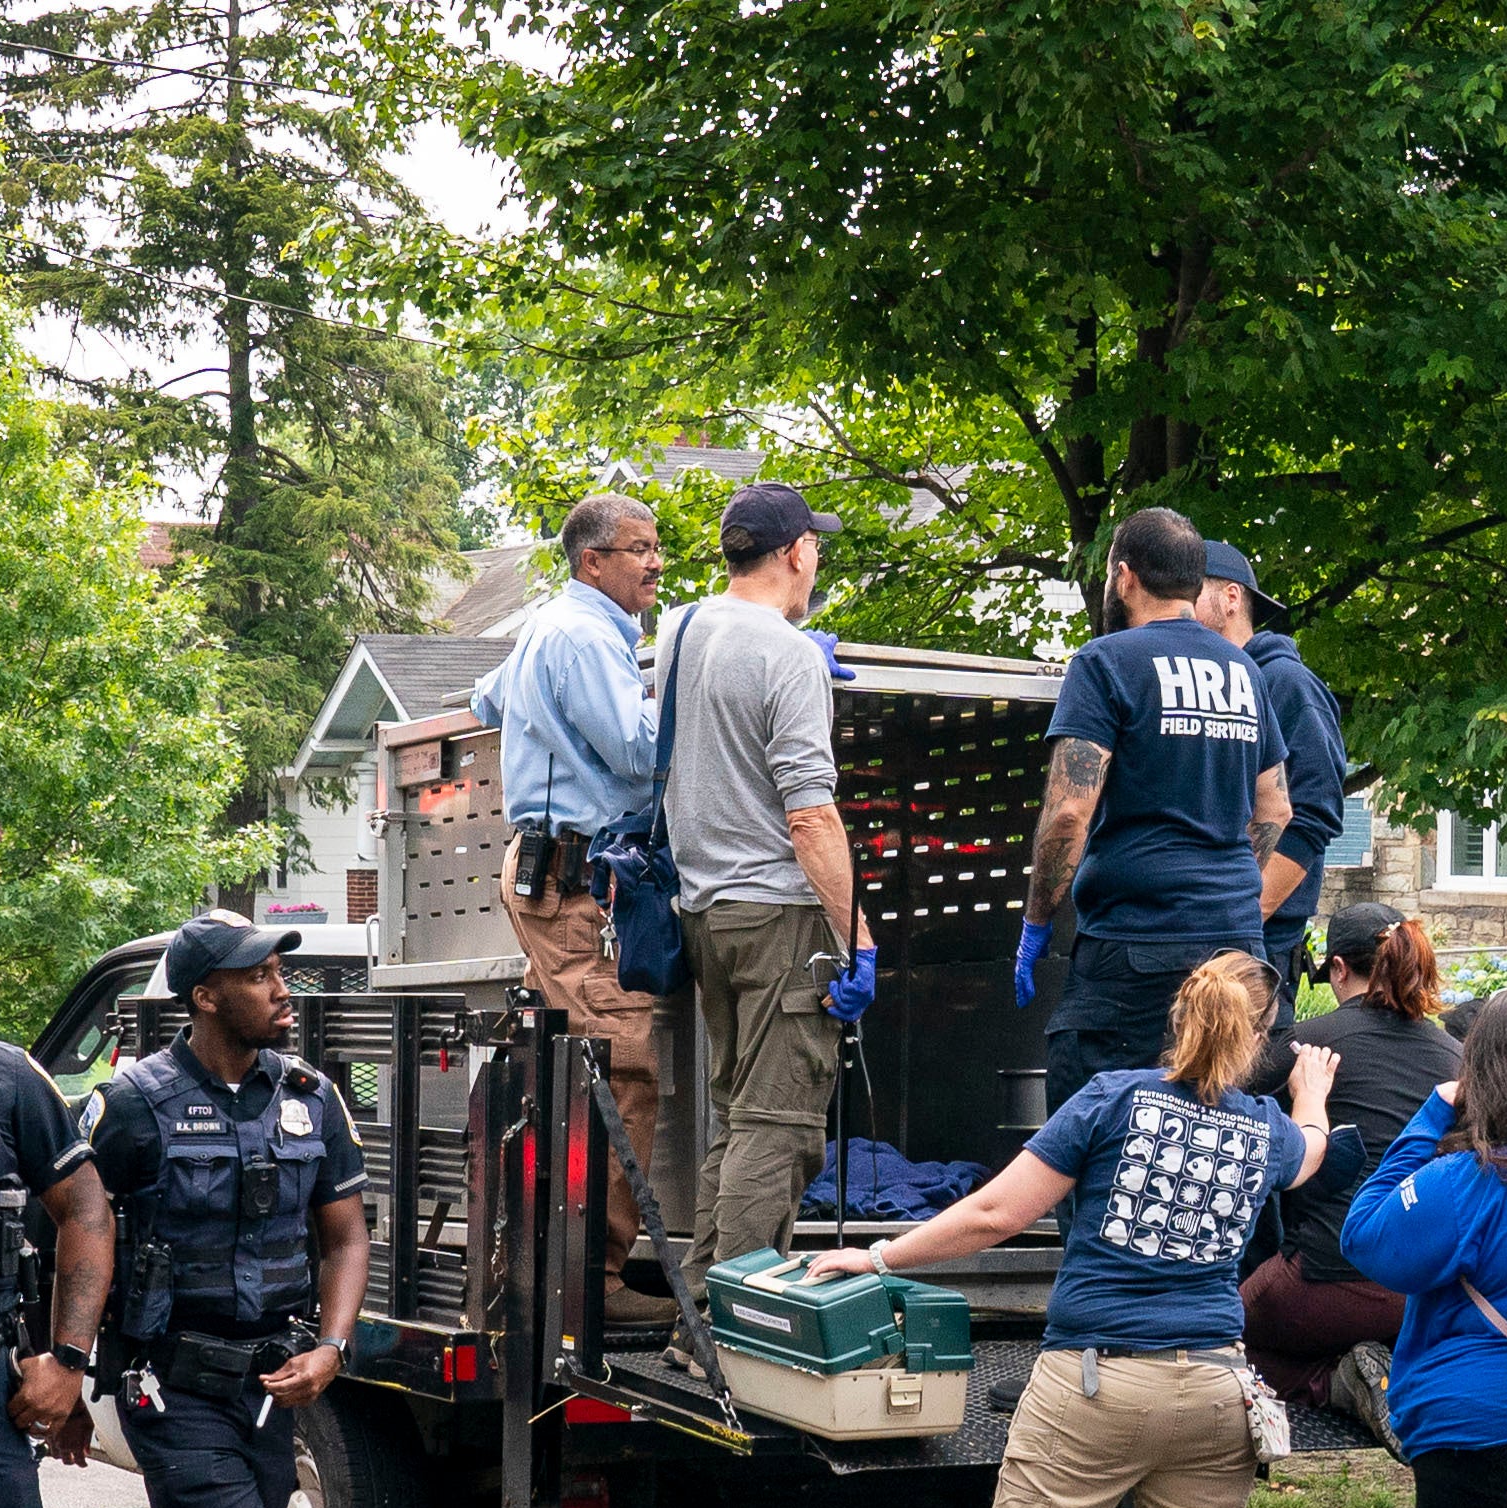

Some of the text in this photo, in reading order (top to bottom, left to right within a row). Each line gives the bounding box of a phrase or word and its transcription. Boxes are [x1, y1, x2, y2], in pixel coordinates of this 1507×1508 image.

[1152, 656, 1258, 717] HRA
[1160, 717, 1258, 743] FIELD SERVICES
[188, 1105, 213, 1115] (FTO)
[192, 1121, 221, 1131] BROWN
[1133, 1089, 1206, 1114] SMITHSONIAN'S
[1254, 1118, 1271, 1131] ZOO
[1140, 1097, 1200, 1120] CONSERVATION
[1201, 1113, 1237, 1128] BIOLOGY
[1236, 1122, 1271, 1139] INSTITUTE
